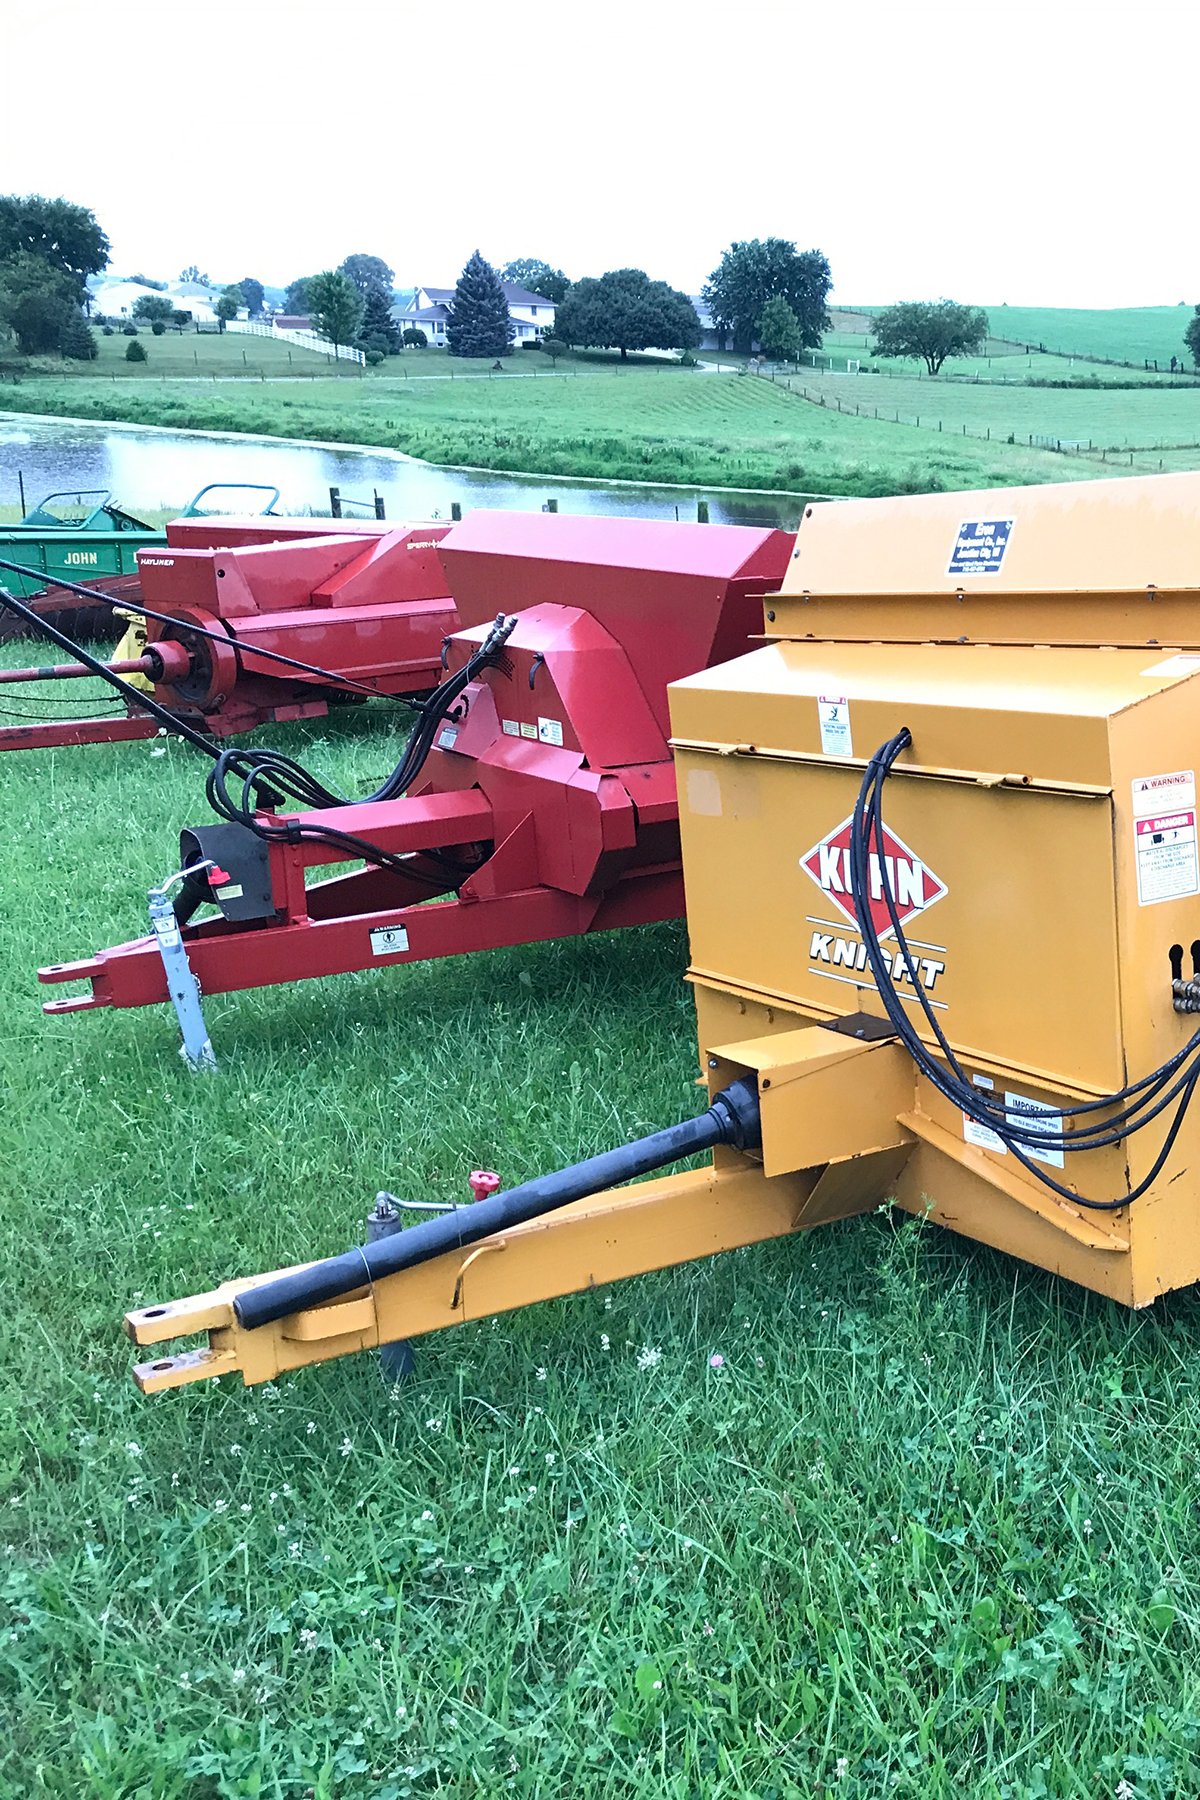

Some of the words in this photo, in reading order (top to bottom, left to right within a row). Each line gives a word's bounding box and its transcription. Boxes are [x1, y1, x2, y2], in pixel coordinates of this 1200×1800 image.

[64, 552, 97, 564] JOHN
[140, 558, 174, 566] HAYLINER
[1151, 775, 1185, 788] WARNING
[1153, 815, 1188, 831] DANGER
[809, 931, 946, 990] KNIGHT
